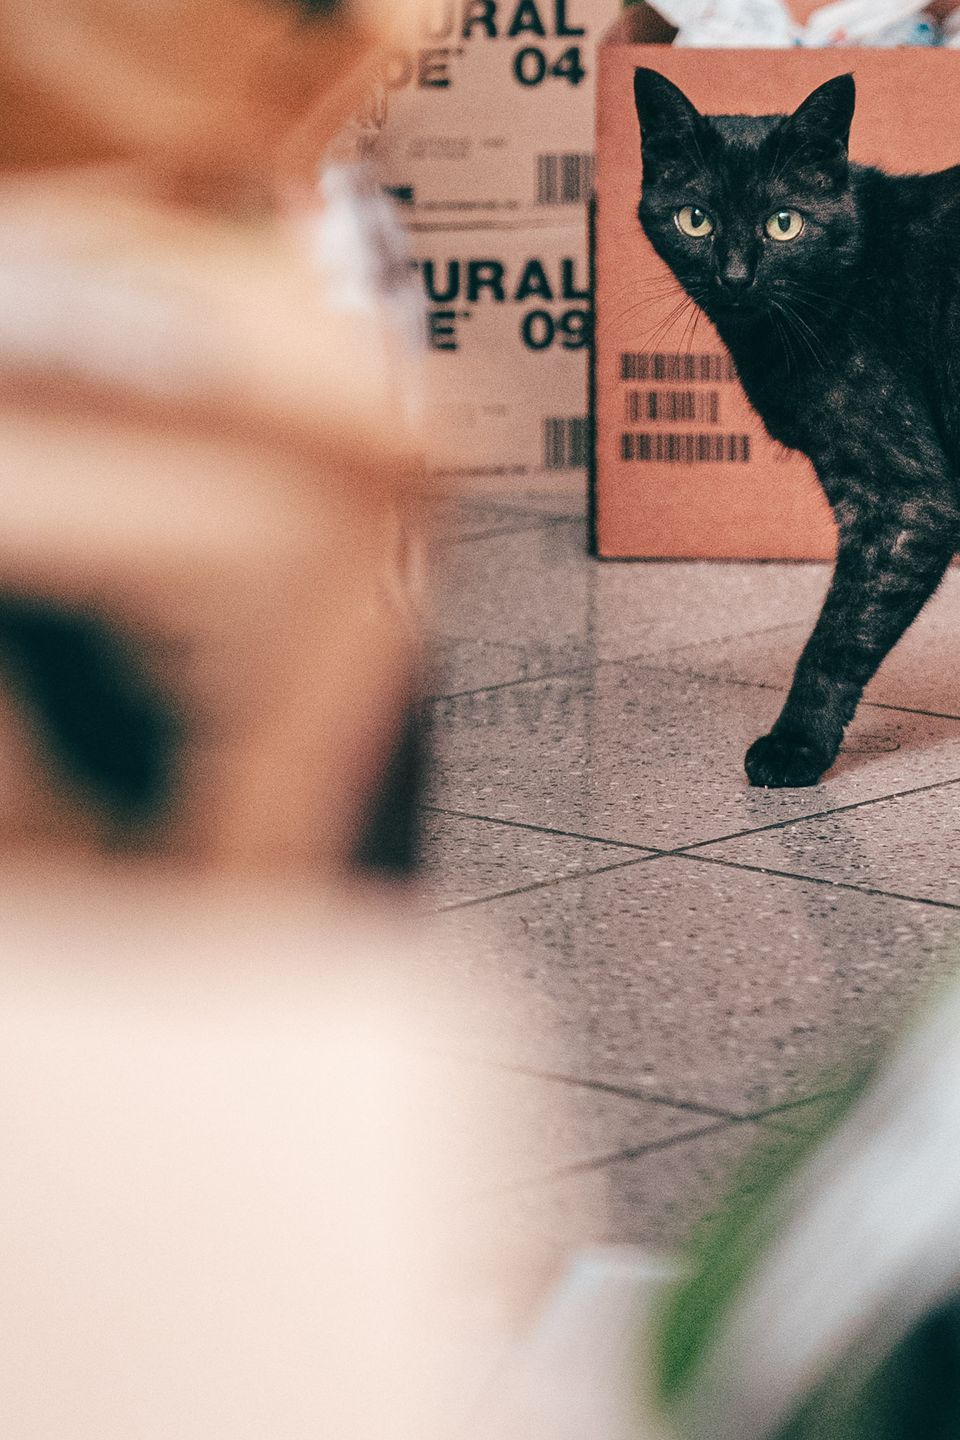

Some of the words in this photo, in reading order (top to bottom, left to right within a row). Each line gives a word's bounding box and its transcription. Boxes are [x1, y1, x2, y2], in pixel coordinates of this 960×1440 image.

[512, 46, 586, 87] 04
[410, 258, 591, 303] URAL
[520, 309, 591, 351] 09
